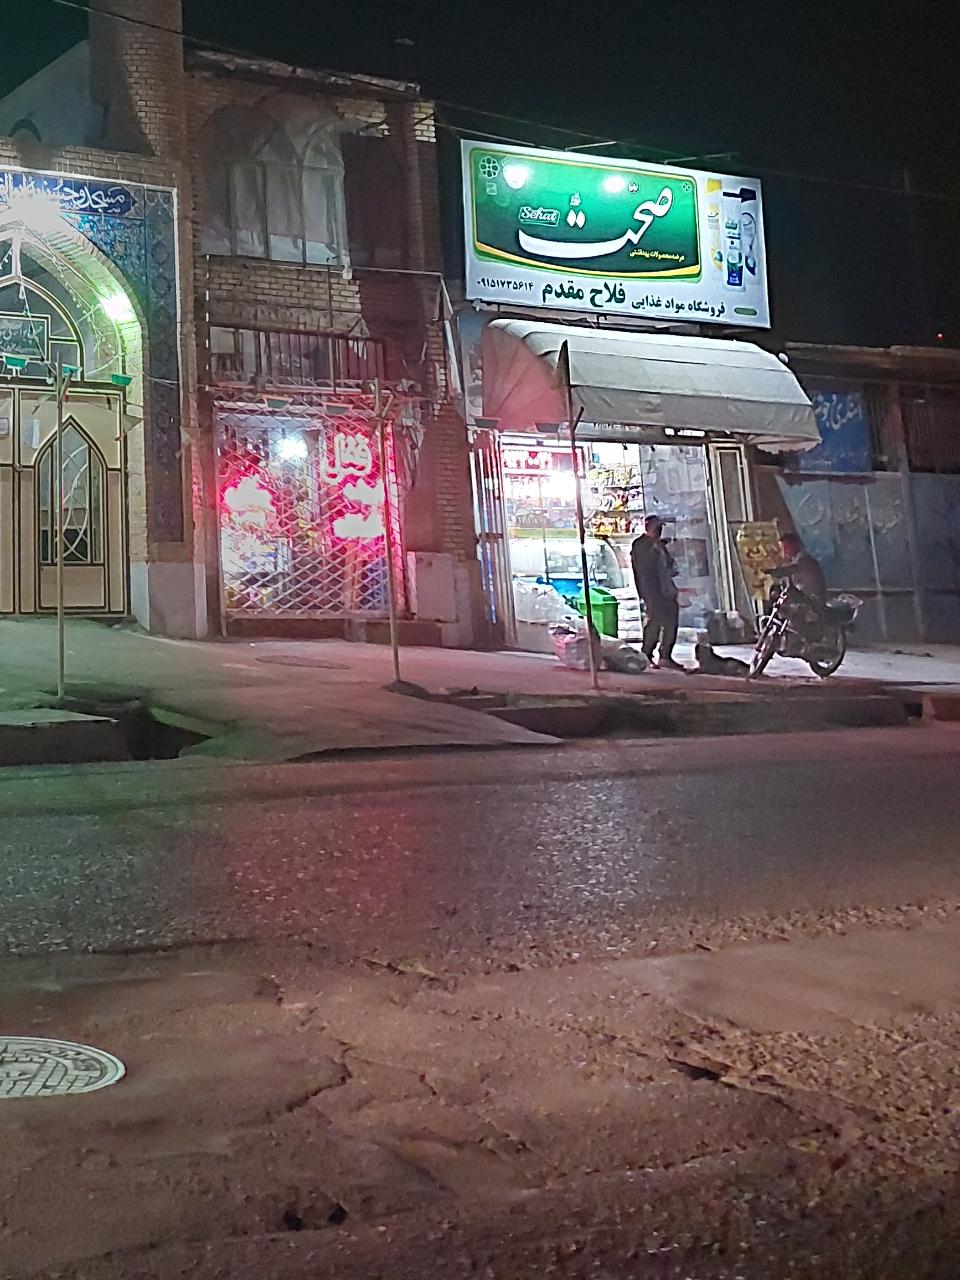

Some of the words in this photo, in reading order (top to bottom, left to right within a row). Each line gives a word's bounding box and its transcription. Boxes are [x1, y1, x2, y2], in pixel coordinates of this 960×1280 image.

[542, 280, 585, 303] مقدم
[589, 281, 626, 307] فلاح
[631, 295, 662, 310] غذایی
[665, 297, 686, 313] مواد
[688, 299, 726, 317] فروشگاه
